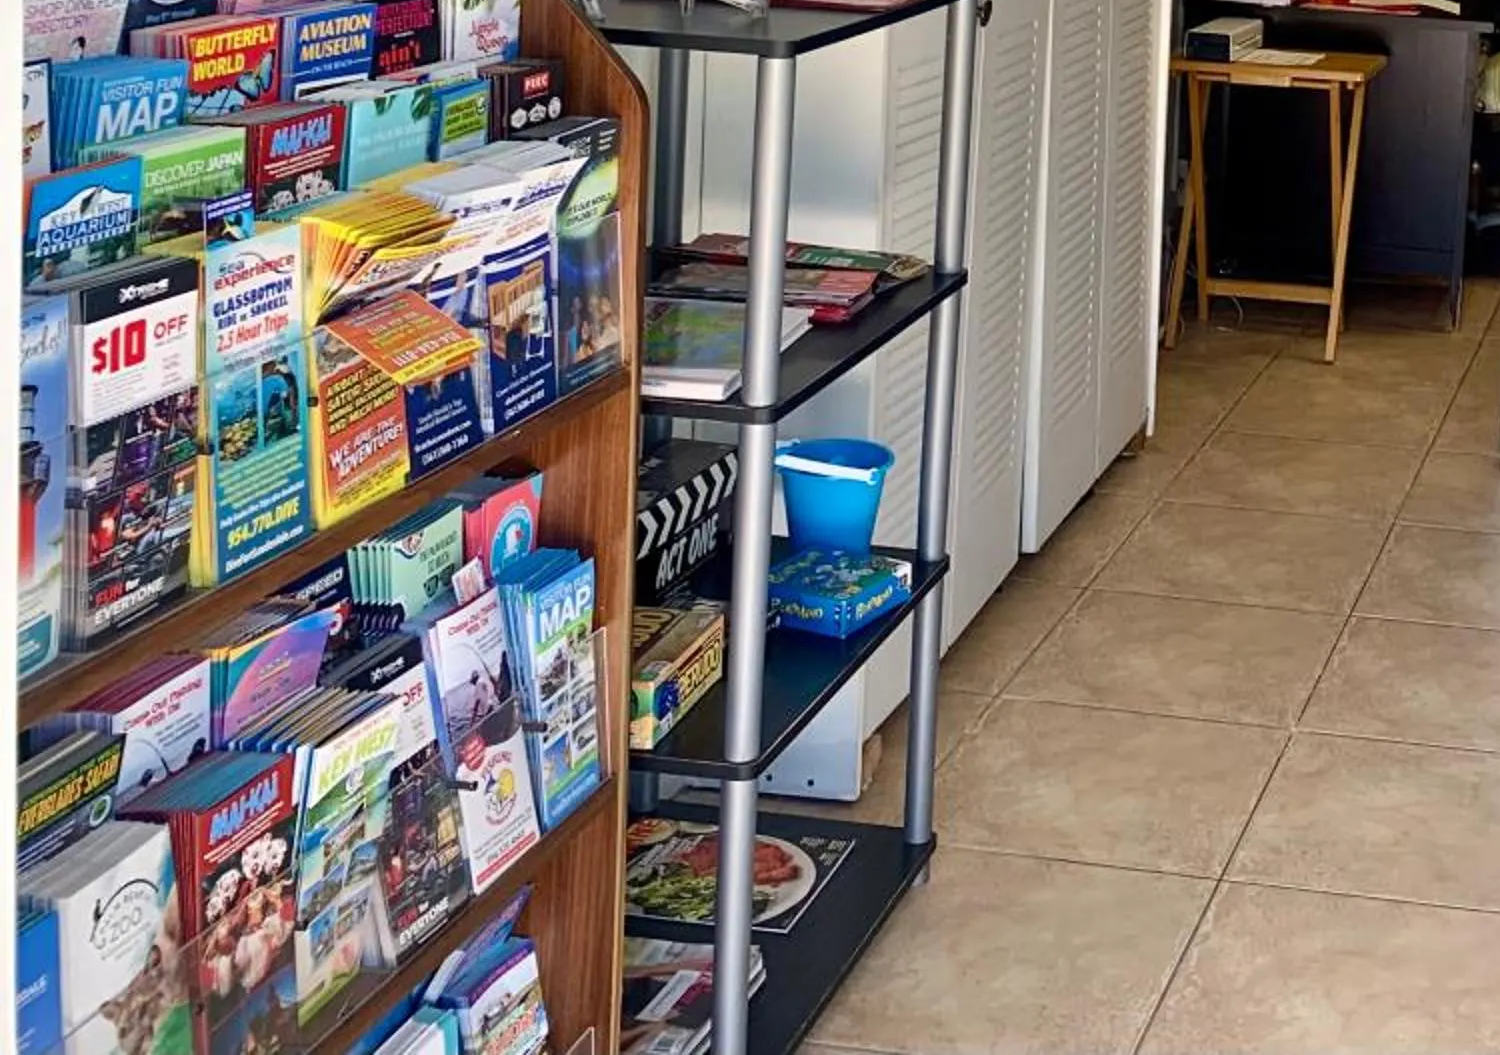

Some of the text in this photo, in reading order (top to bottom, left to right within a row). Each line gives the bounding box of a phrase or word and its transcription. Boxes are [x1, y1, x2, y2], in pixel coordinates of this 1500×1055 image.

[194, 22, 278, 58] BUTTERFLY
[299, 12, 373, 42] AVIATION
[299, 34, 367, 63] MUSEUM
[193, 55, 245, 82] WORLD
[103, 81, 153, 102] VISITOR
[155, 76, 183, 95] FUN
[96, 91, 178, 143] MAP
[270, 114, 332, 158] MAI-KAI
[145, 150, 243, 188] DISCOVER JAPAN
[40, 210, 132, 247] AQUARIUM
[214, 254, 296, 291] experience
[212, 276, 293, 318] GLASSBOTTOM
[92, 318, 147, 375] $10
[153, 313, 188, 340] OFF
[235, 321, 263, 346] Hour
[264, 312, 289, 340] Trips
[654, 511, 720, 590] ACT ONE
[95, 580, 123, 606] FUN
[95, 575, 166, 626] EVERYONE
[539, 584, 593, 642] MAP
[210, 770, 280, 841] MAI-KAI
[399, 896, 450, 945] EVERYONE
